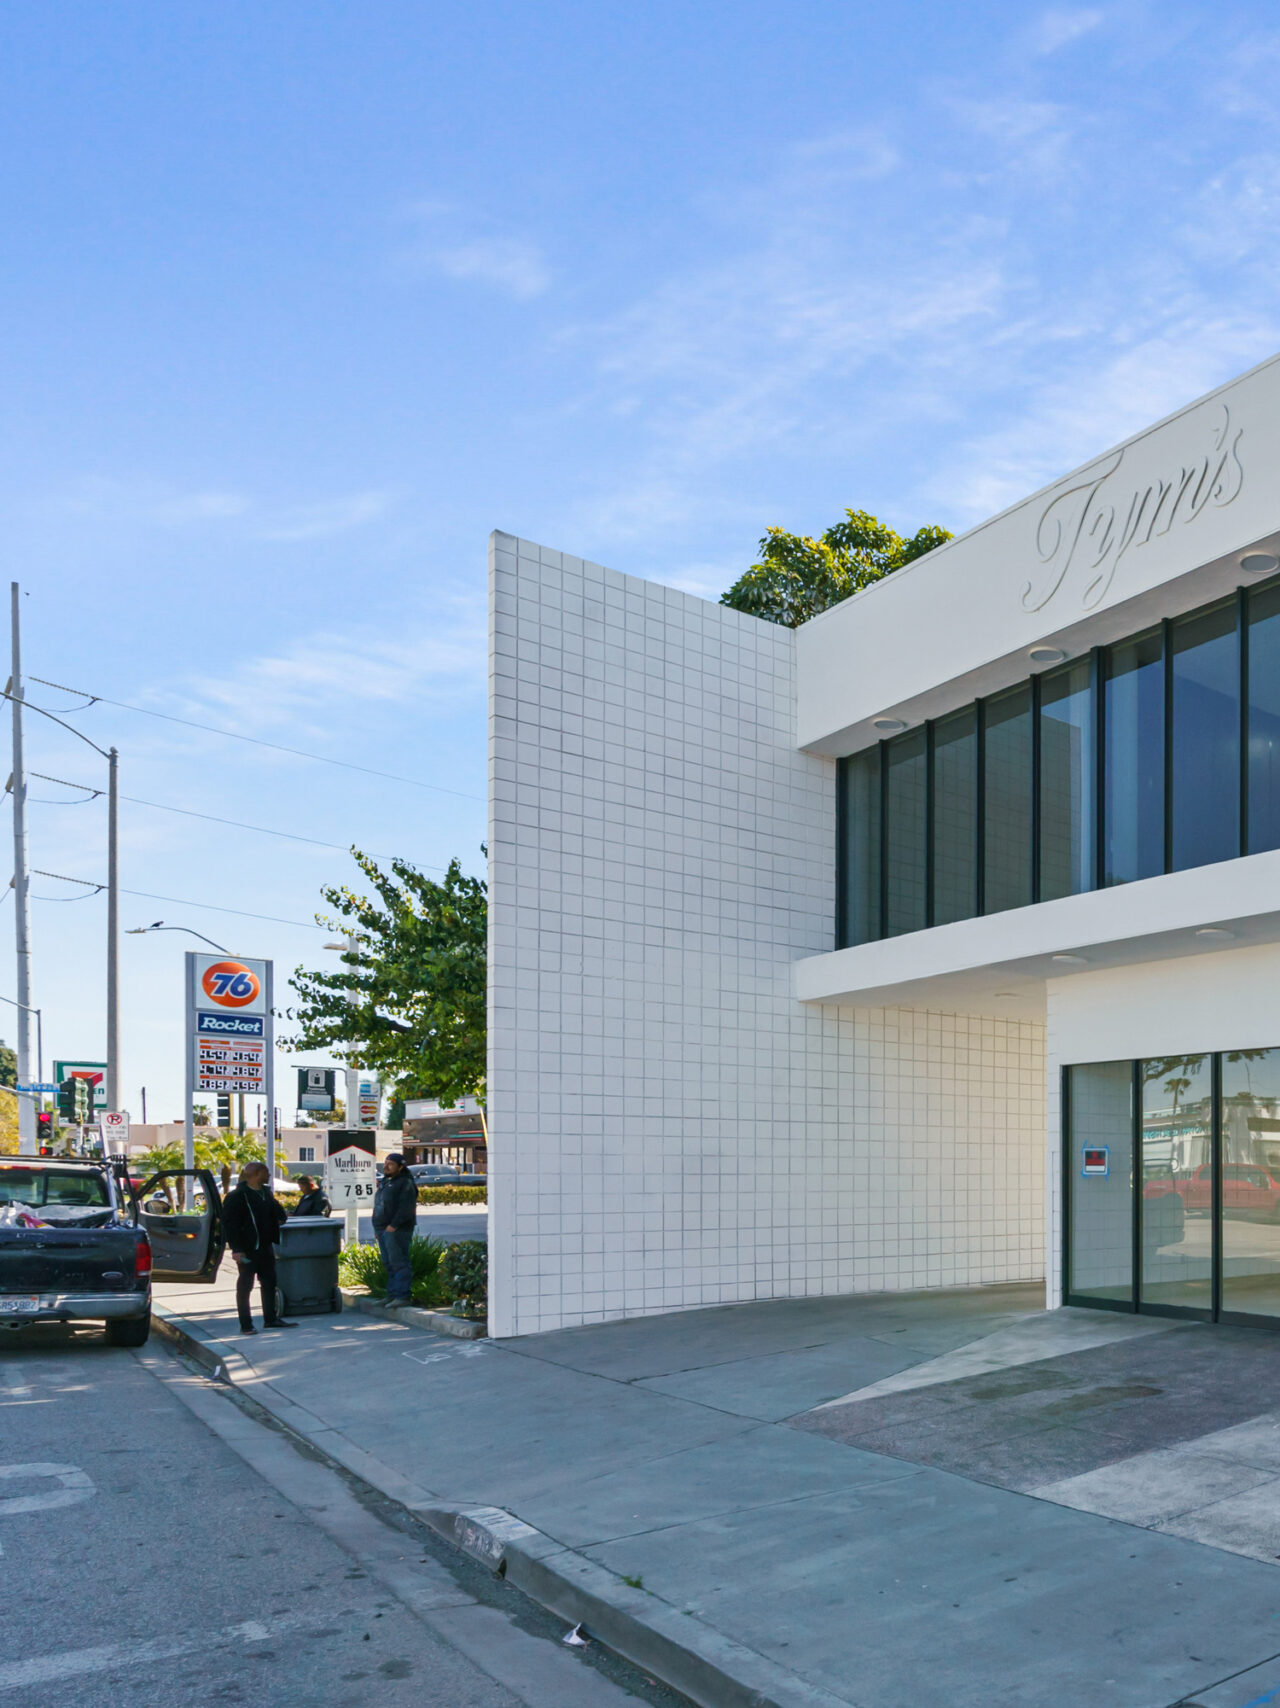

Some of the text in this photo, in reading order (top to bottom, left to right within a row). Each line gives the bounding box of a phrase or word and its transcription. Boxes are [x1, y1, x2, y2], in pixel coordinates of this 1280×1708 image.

[210, 972, 254, 999] 76
[201, 1016, 261, 1033] Rocket
[334, 1153, 371, 1168] Marlboro
